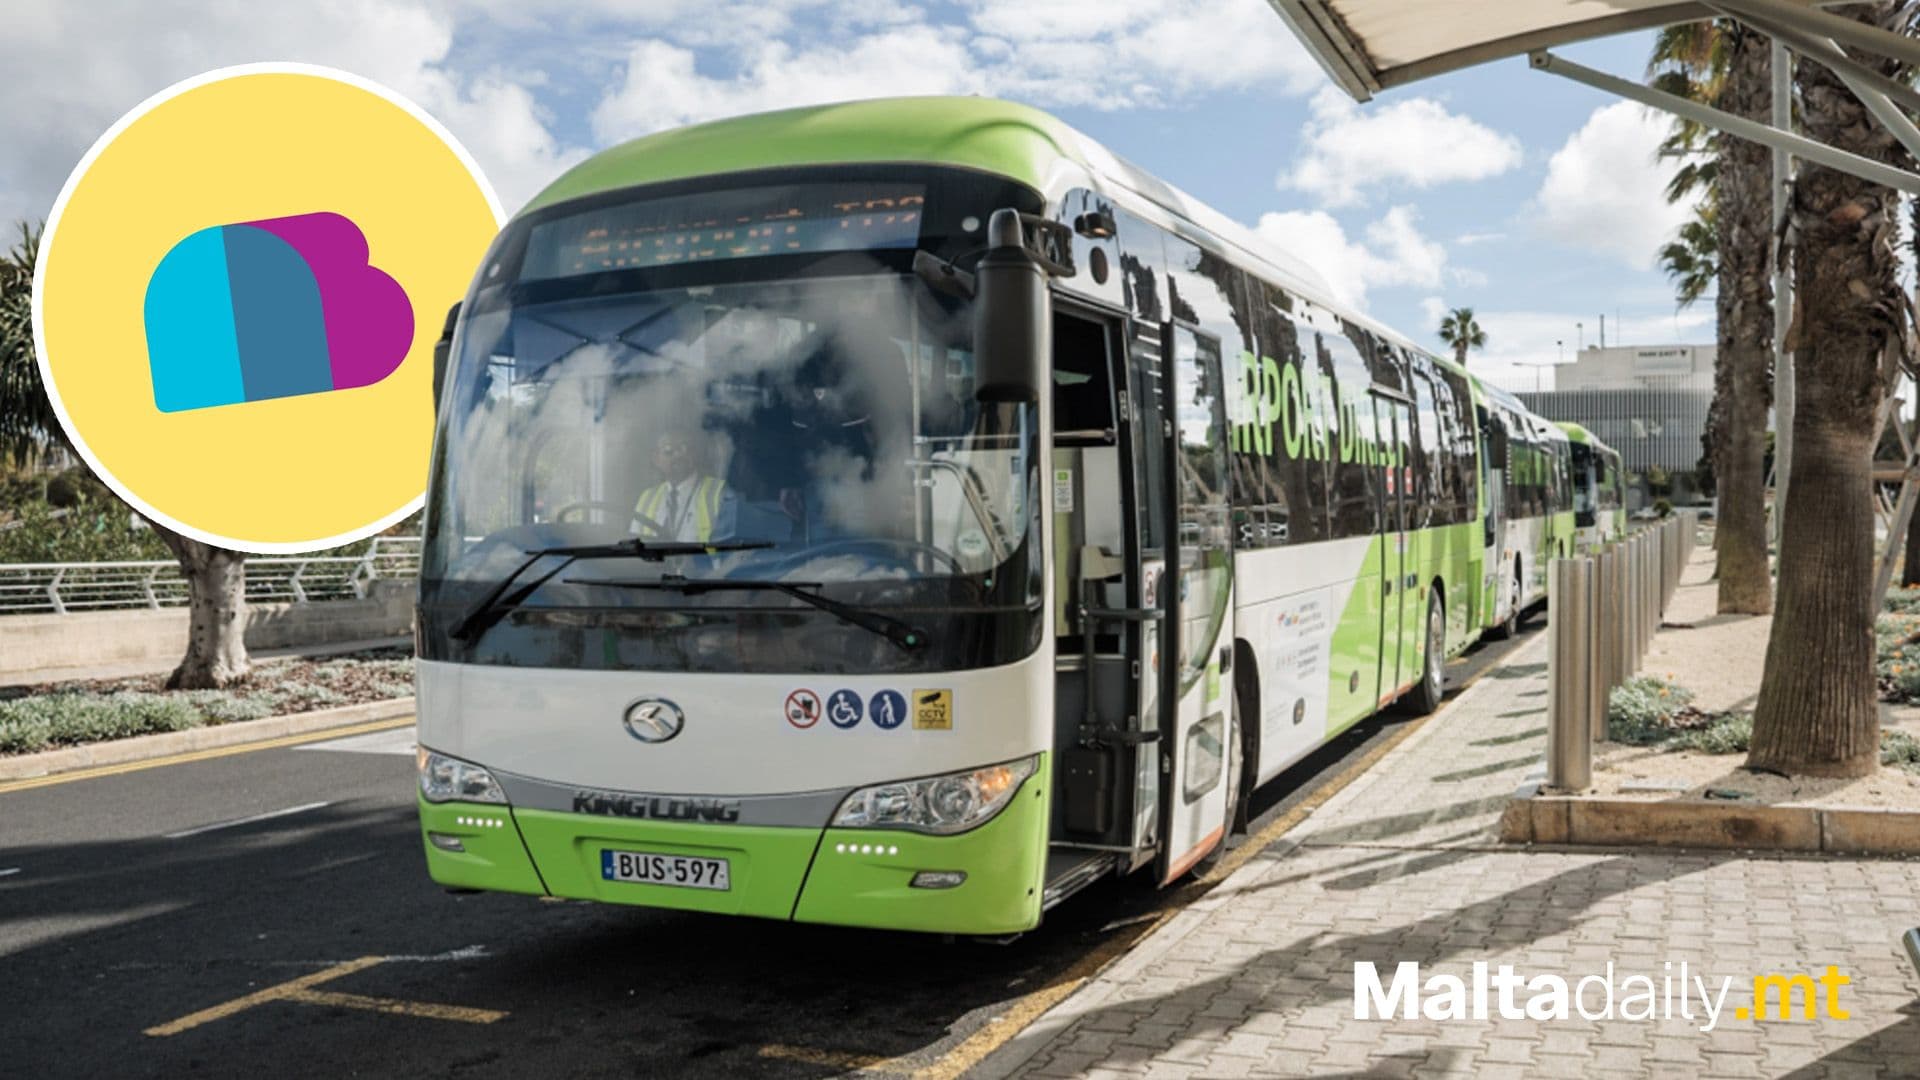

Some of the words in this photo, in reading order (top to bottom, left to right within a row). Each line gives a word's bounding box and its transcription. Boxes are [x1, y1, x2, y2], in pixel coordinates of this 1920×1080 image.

[918, 708, 946, 719] CCTV
[573, 791, 647, 819] KING
[649, 797, 741, 823] LONG
[619, 854, 665, 881] BUS
[674, 858, 720, 886] 597
